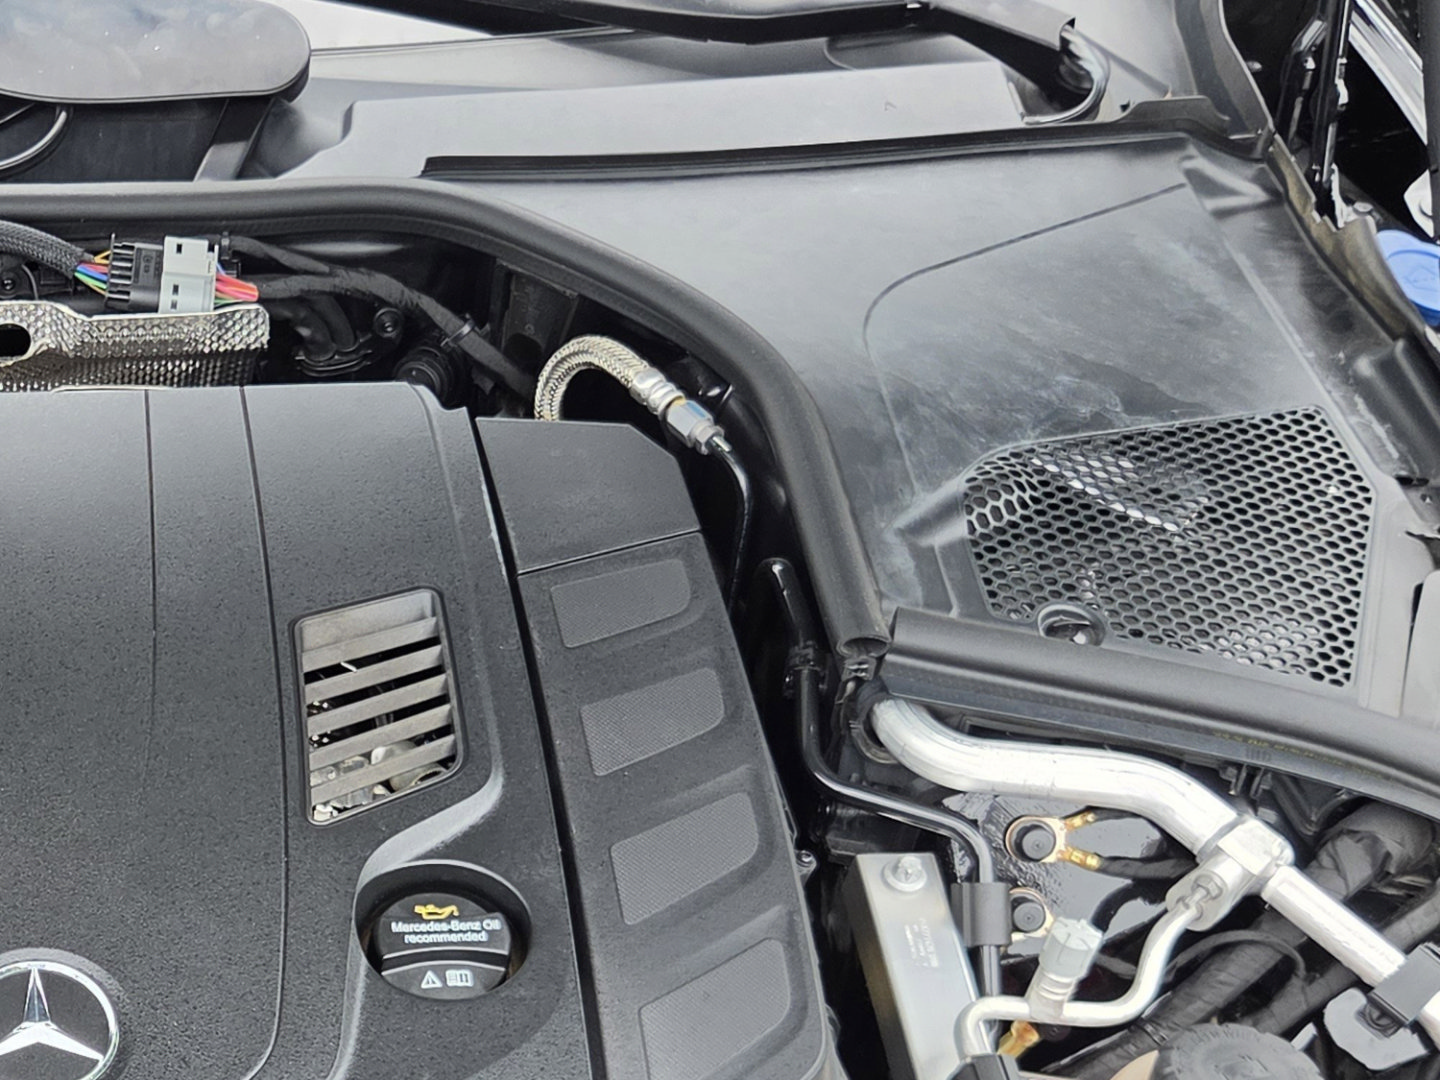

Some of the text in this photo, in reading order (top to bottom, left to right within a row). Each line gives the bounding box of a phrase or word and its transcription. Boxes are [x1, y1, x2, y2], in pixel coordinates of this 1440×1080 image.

[391, 919, 502, 932] Mercedes-Benz Oil
[404, 931, 489, 944] recommended
